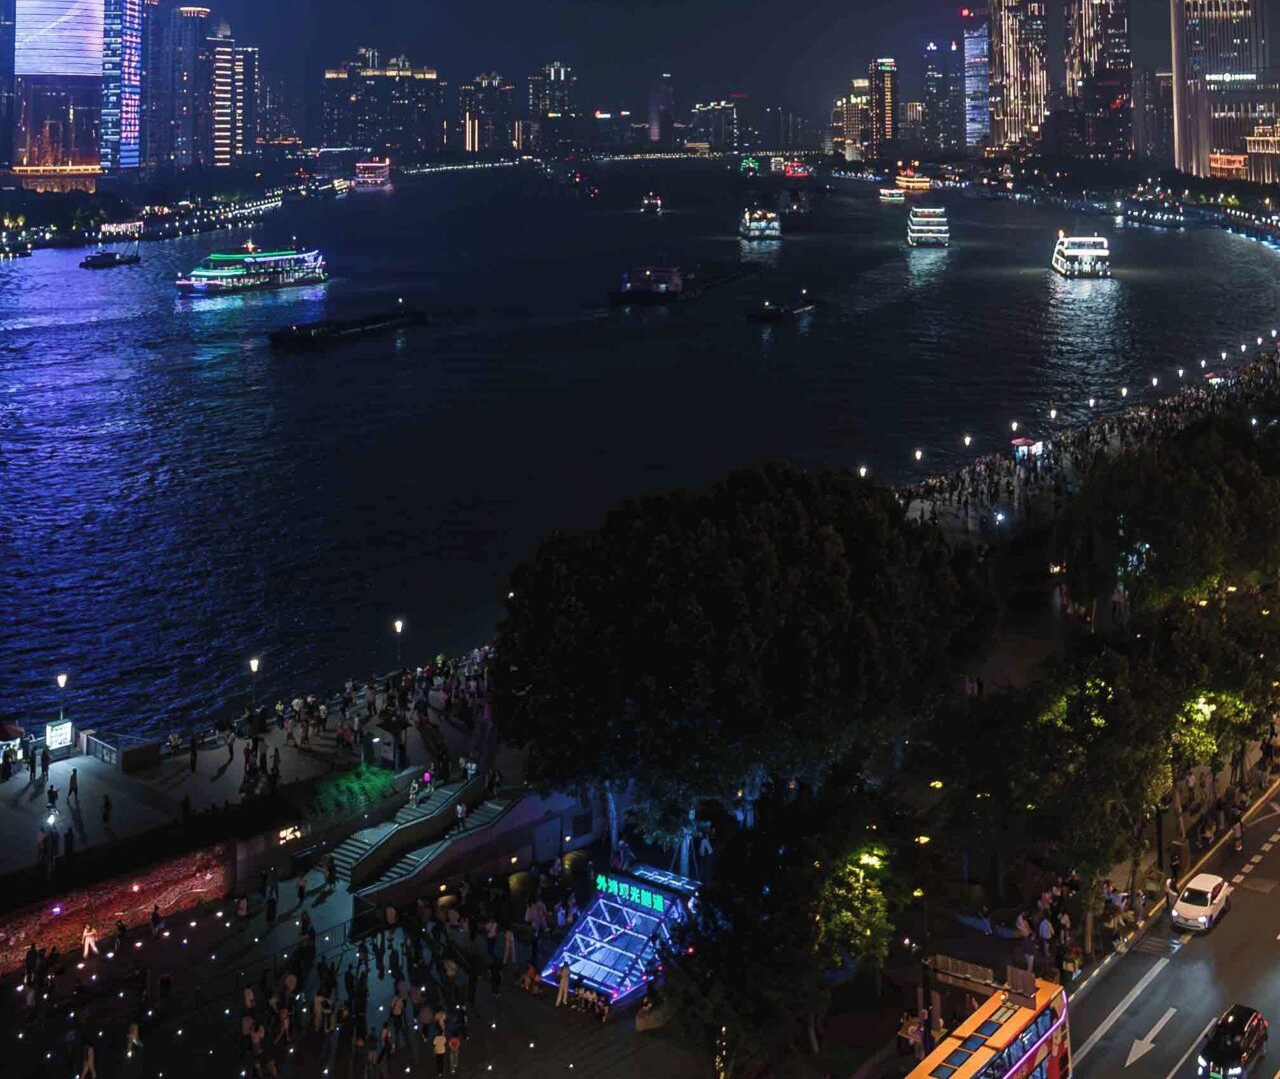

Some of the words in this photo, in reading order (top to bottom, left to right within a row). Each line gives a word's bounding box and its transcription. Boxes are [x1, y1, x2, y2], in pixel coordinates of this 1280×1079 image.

[596, 874, 664, 912] 外滩观光隧道
